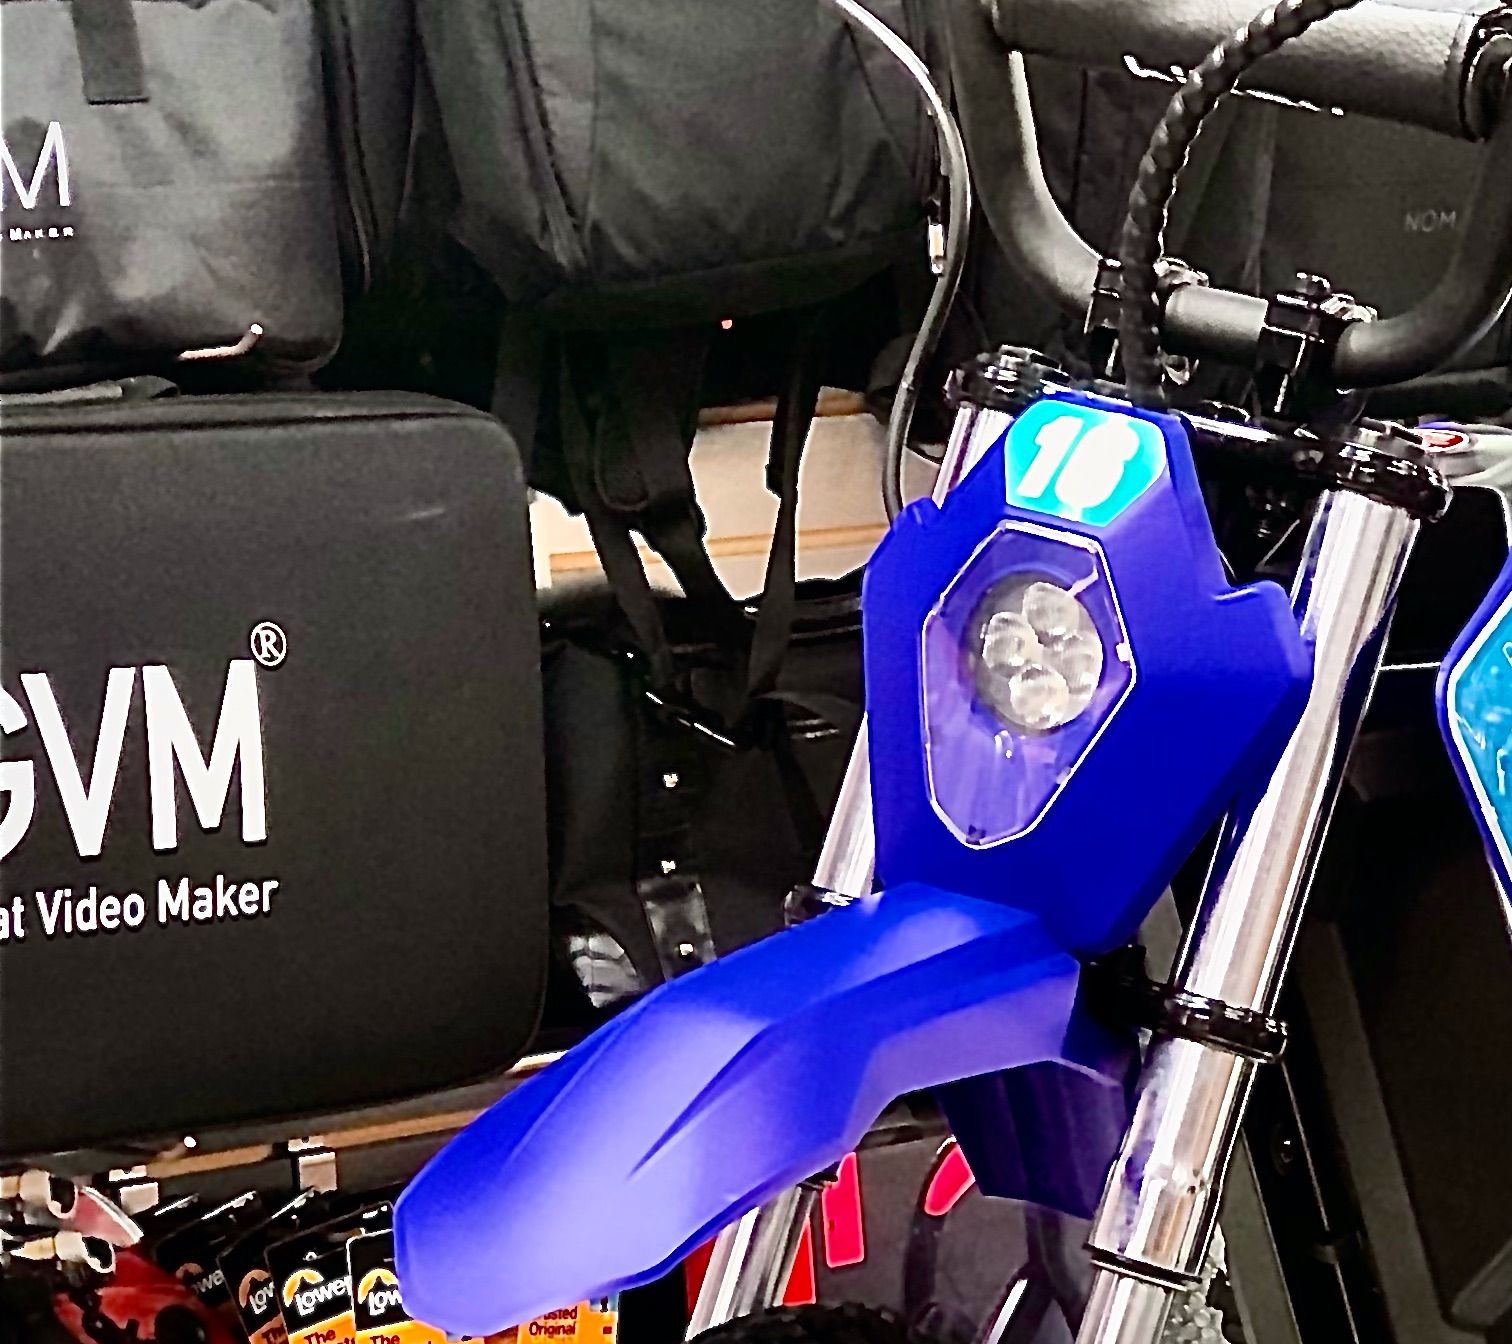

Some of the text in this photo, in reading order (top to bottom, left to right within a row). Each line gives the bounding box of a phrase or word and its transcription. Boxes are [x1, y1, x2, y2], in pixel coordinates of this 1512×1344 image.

[36, 886, 145, 936] Video
[158, 874, 280, 925] Maker
[529, 1321, 577, 1339] Original
